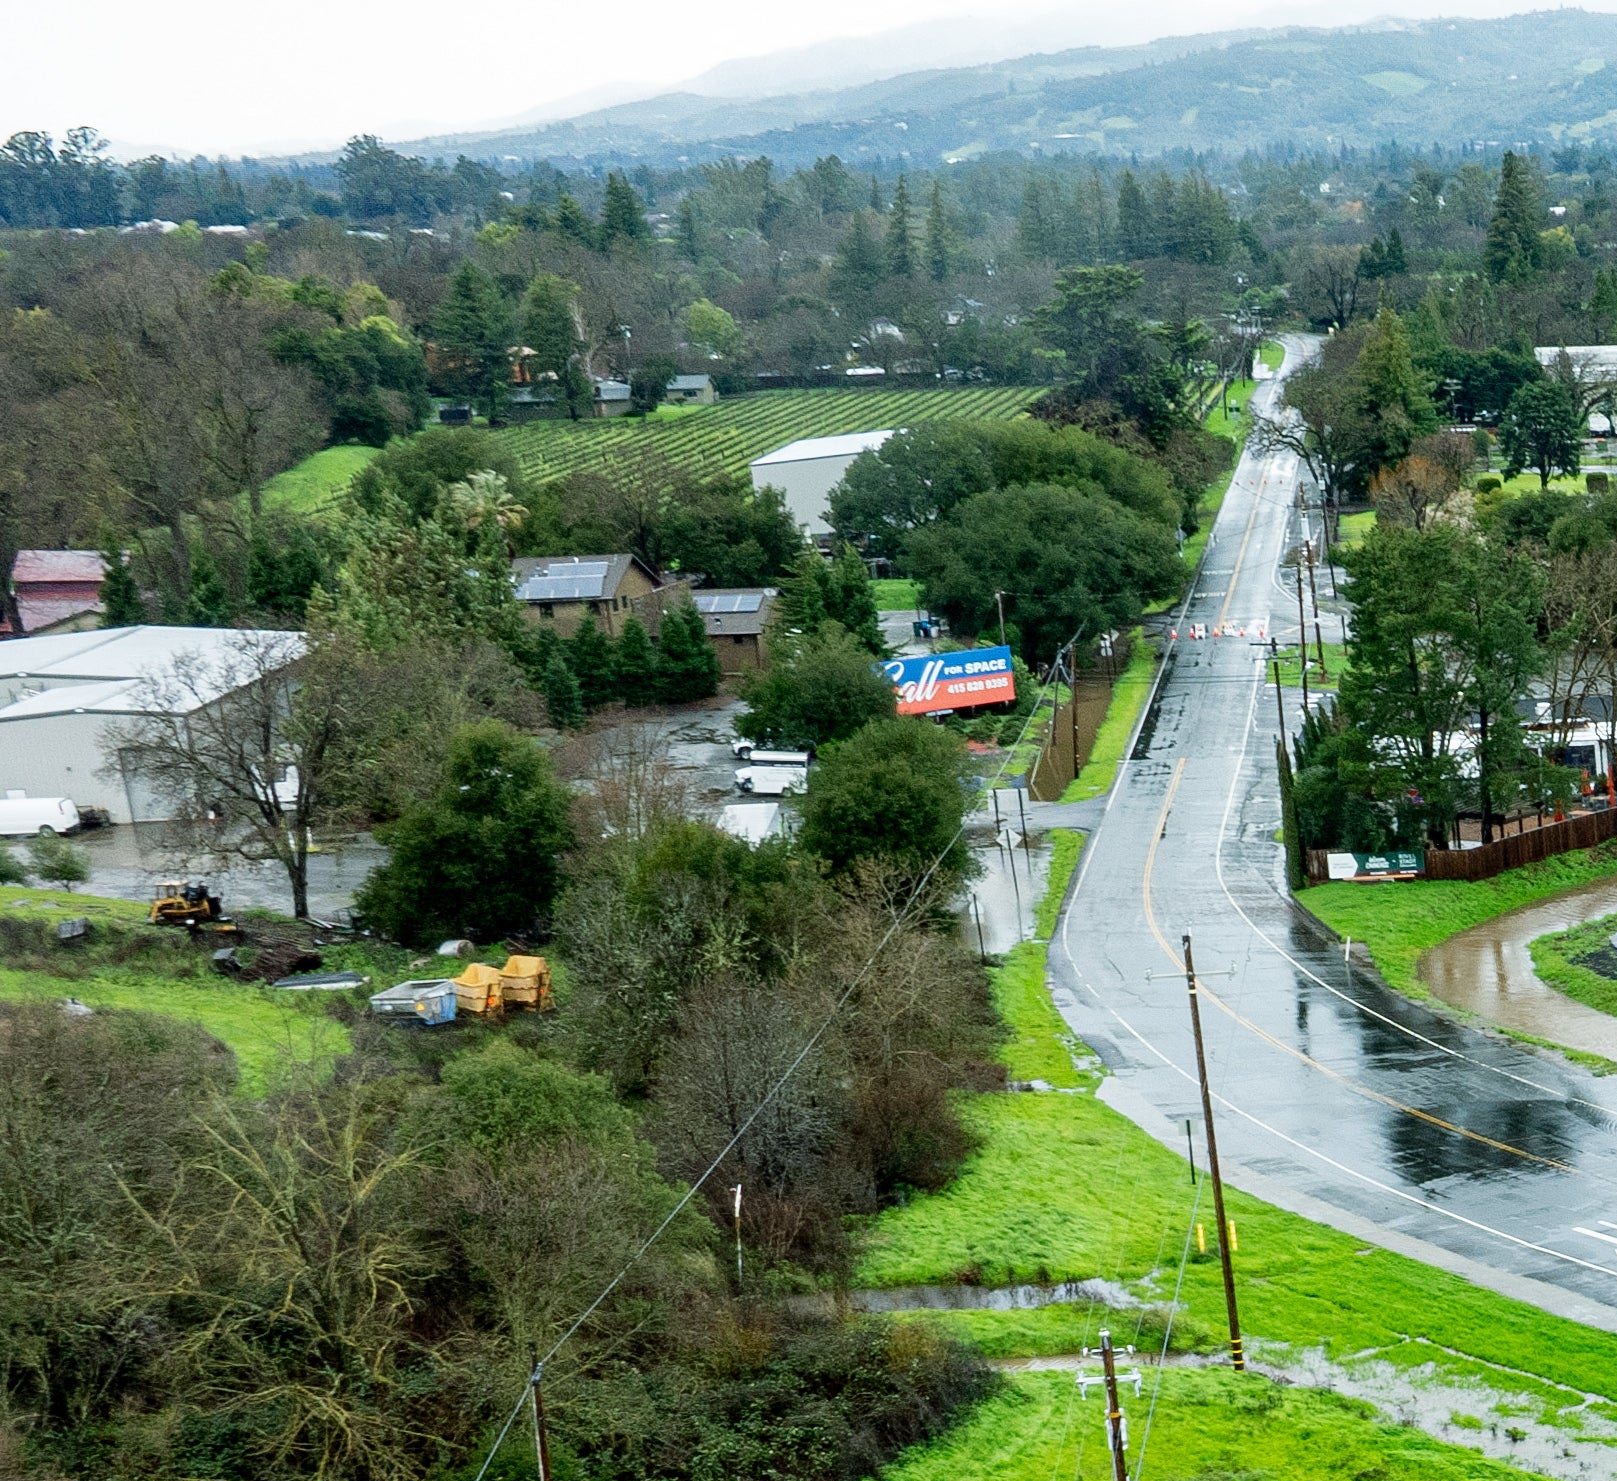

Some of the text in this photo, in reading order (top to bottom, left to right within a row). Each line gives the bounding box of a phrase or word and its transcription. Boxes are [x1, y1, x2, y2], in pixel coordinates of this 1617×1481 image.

[944, 659, 1006, 675] FOR SPACE
[948, 683, 966, 693] 415
